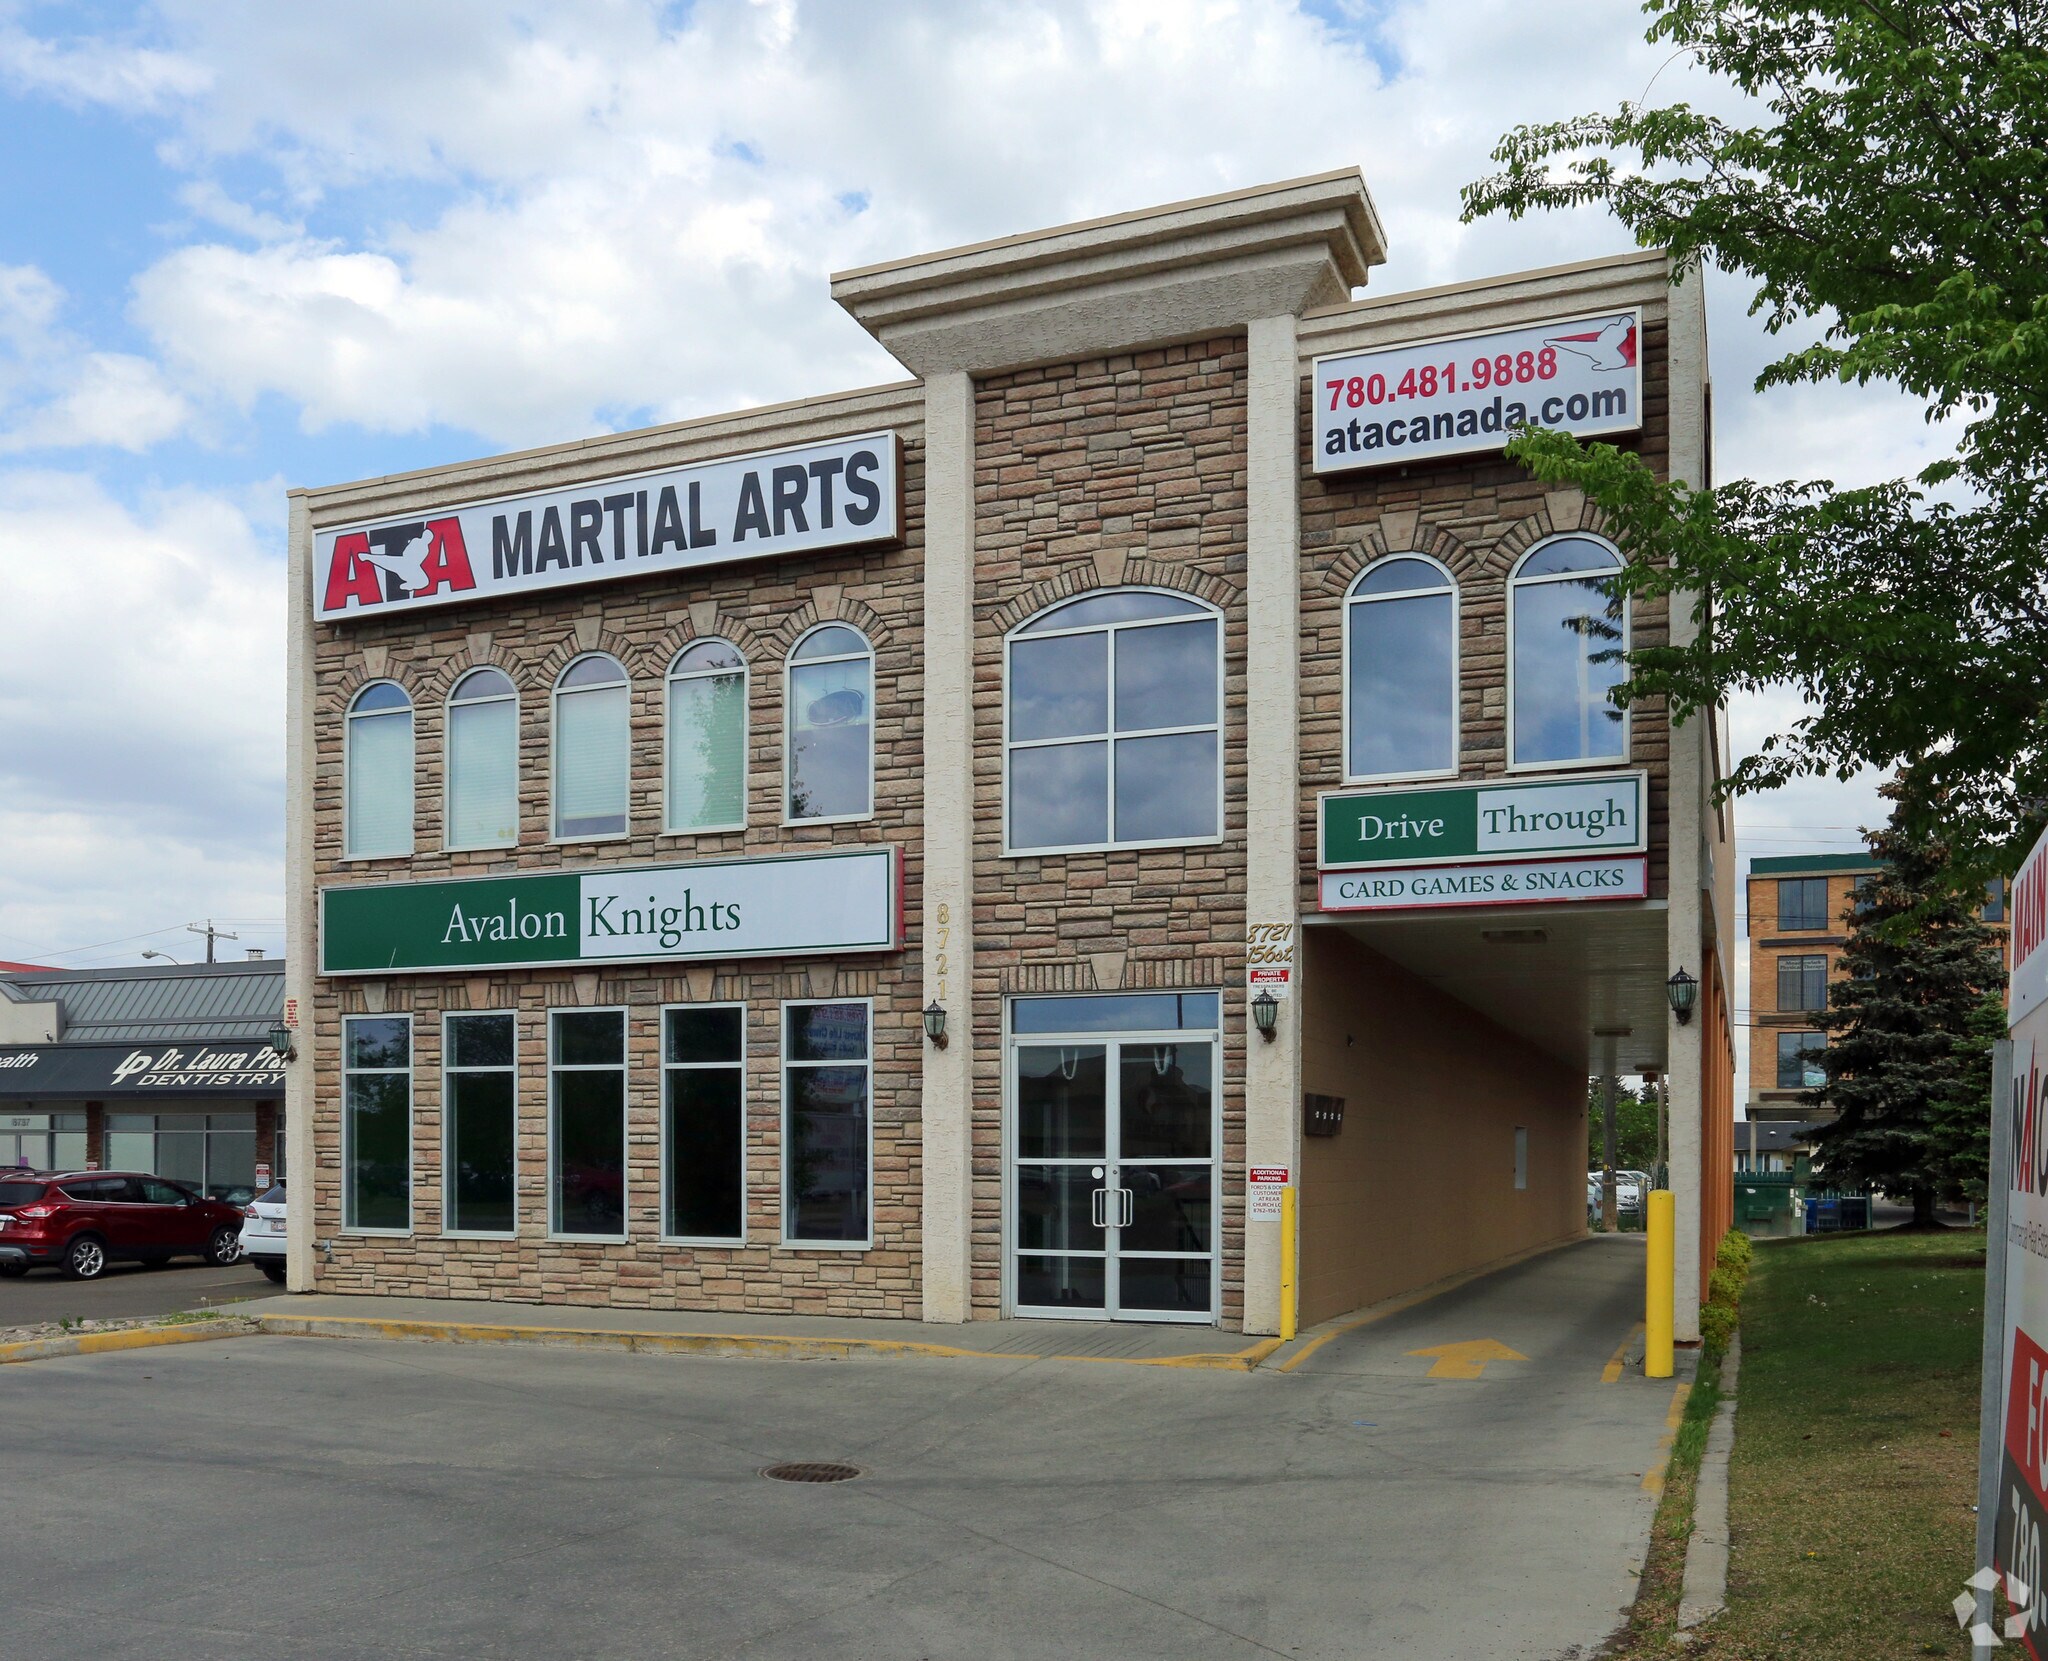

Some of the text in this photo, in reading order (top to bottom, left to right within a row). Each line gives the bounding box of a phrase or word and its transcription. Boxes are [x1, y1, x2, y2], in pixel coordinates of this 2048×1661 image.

[1326, 347, 1557, 411] 780.481.9888
[1325, 387, 1627, 455] atacanada.com
[492, 450, 880, 579] MARTIAL ARTS
[323, 515, 476, 611] ATA
[1358, 799, 1627, 841] Drive Through
[1340, 869, 1624, 899] CARD GAMES & SNACKS
[441, 889, 741, 948] Avalon Knights
[1246, 923, 1293, 944] 8721
[936, 903, 949, 1001] 8721
[136, 1073, 286, 1086] DENTISTRY
[151, 1046, 286, 1070] Dr. Laura Pra
